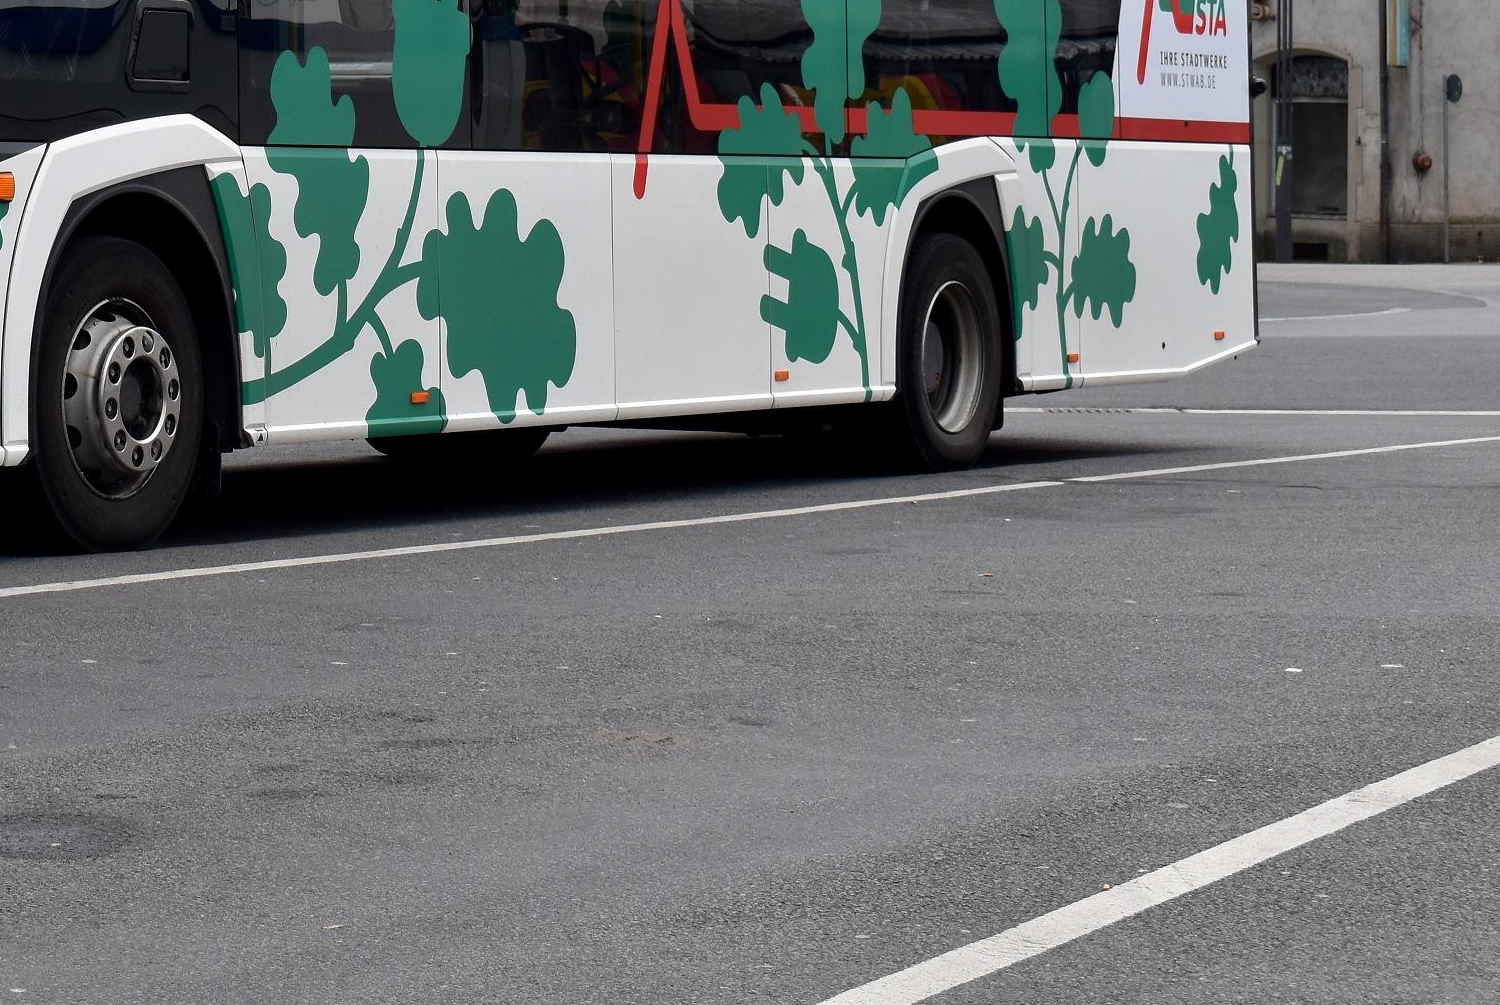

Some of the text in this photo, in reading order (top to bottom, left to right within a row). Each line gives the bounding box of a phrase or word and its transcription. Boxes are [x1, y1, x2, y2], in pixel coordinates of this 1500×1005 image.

[1160, 51, 1228, 70] IHRE STADTWERKE
[1160, 71, 1216, 90] WWW.STWAB.DE
